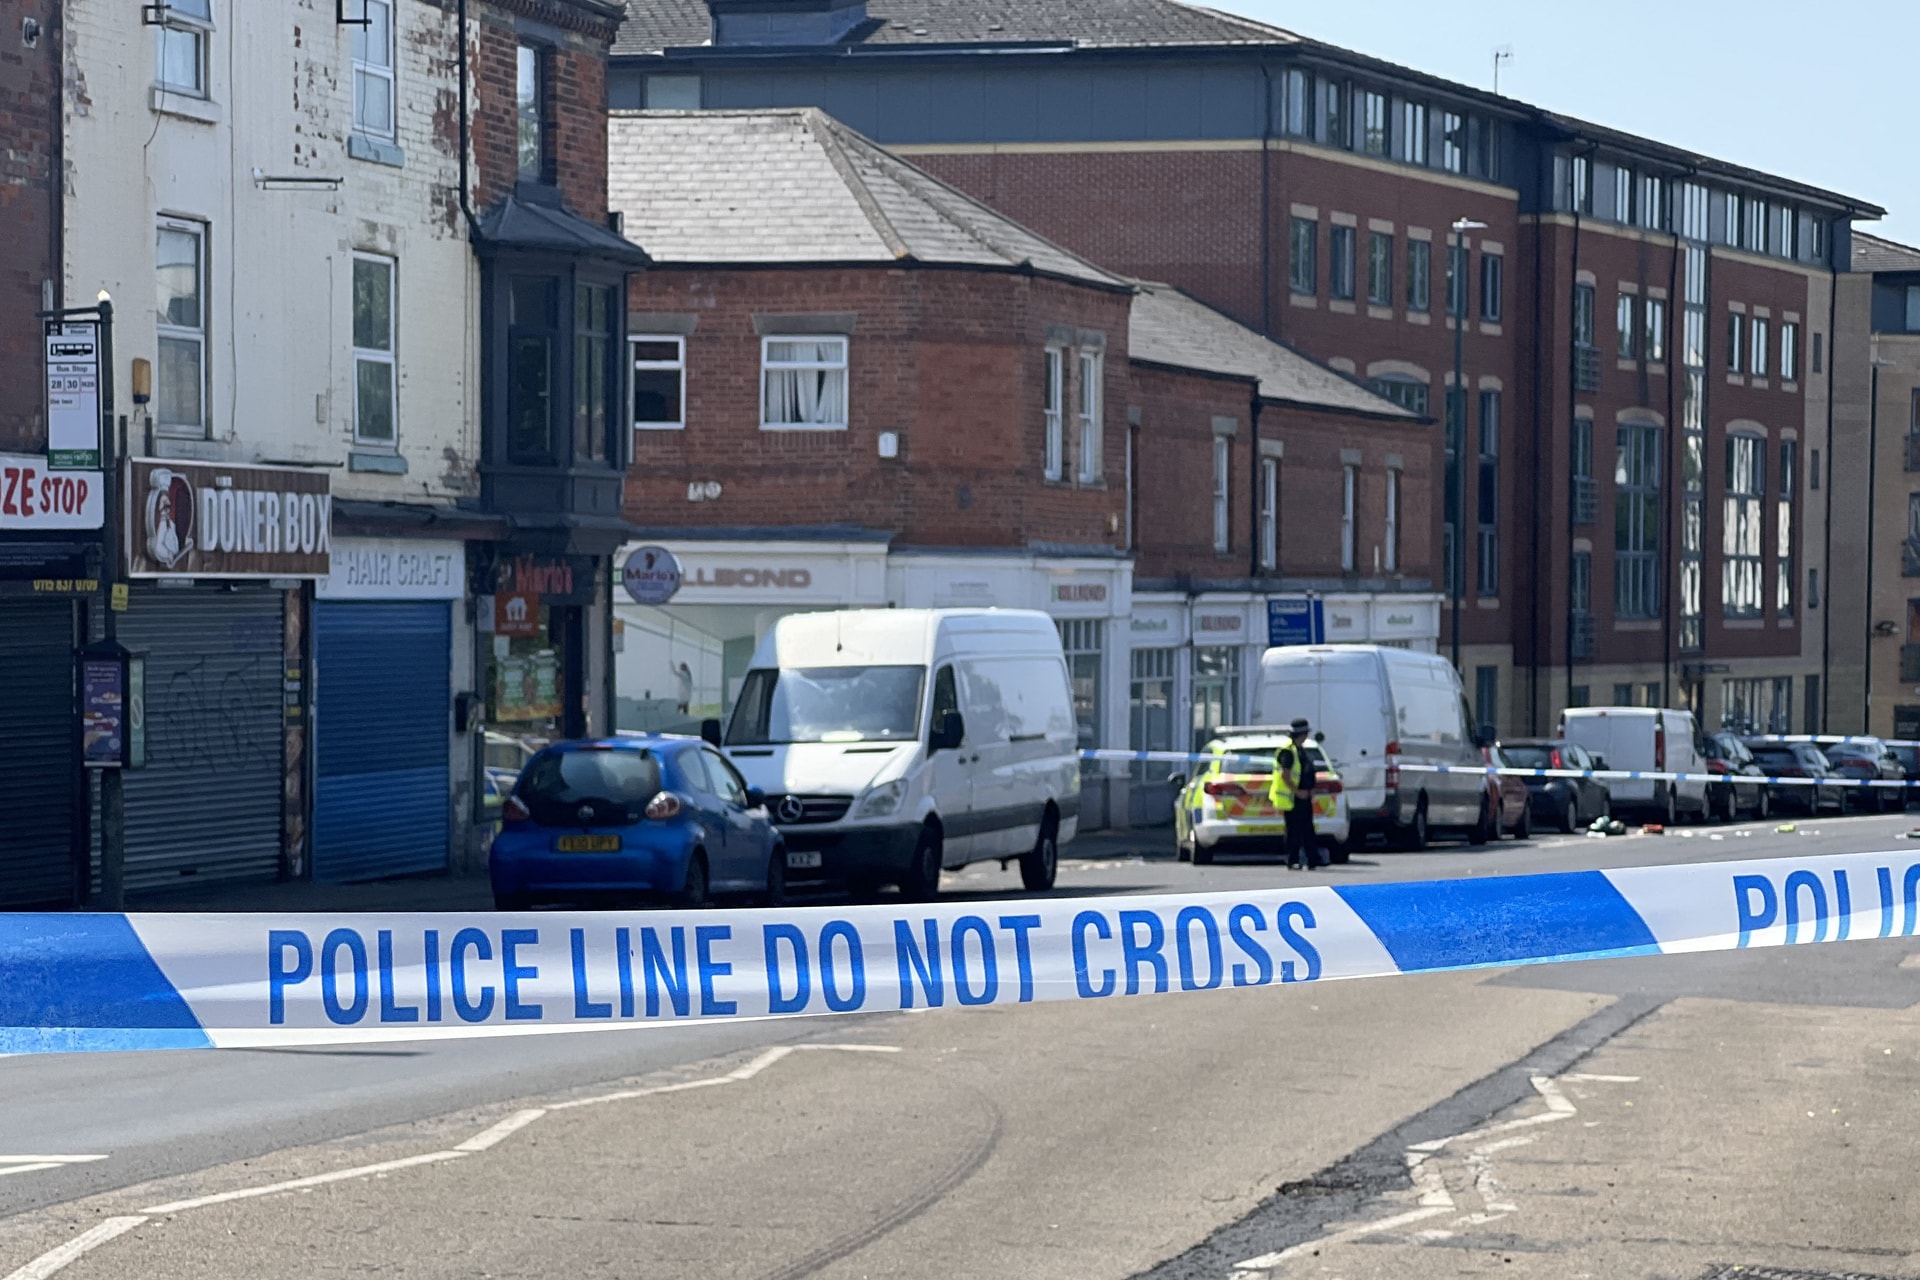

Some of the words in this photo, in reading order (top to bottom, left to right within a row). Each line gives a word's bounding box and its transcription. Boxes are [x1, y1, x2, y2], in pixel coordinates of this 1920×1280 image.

[51, 380, 62, 389] 28
[67, 380, 78, 389] 30
[0, 467, 36, 517] ZE
[39, 476, 88, 515] STOP
[286, 492, 332, 554] BOX
[347, 550, 391, 586] HAIR
[398, 553, 452, 586] CRAFT
[626, 567, 676, 581] Mario's
[268, 927, 543, 1025] POLICE
[570, 925, 738, 1019] LINE
[763, 919, 867, 1014] DO
[894, 914, 1042, 1009] NOT
[1071, 901, 1323, 999] CROSS
